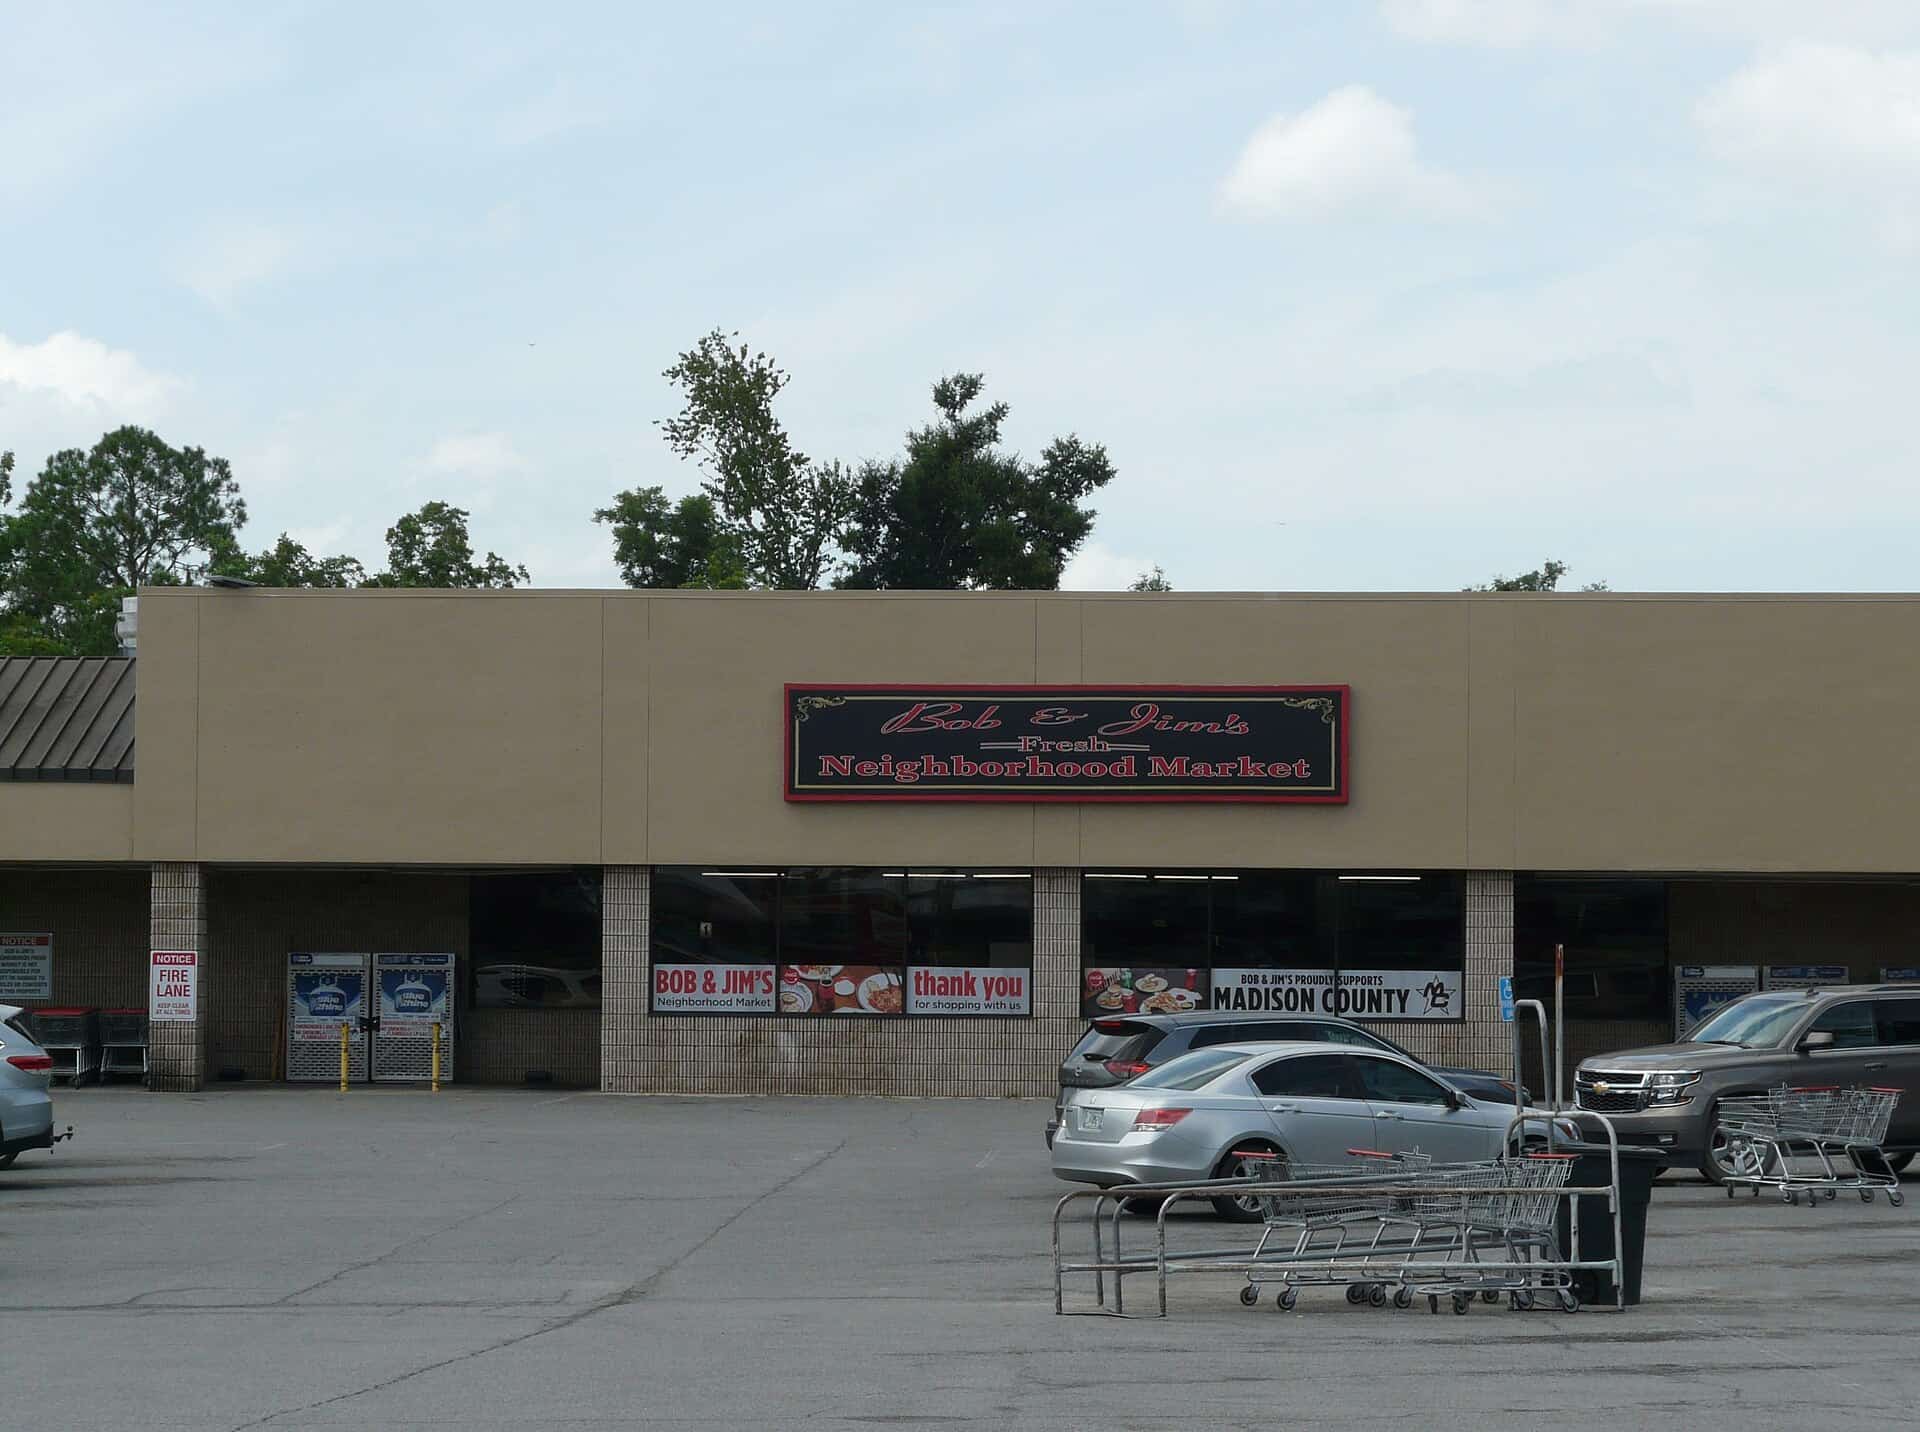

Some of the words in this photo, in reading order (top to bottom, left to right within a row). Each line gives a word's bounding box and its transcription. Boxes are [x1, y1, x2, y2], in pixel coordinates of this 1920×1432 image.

[880, 703, 1002, 734] Bob
[1030, 707, 1089, 725] &
[1097, 703, 1250, 735] Jim's
[1017, 735, 1112, 752] Fresh
[818, 754, 1138, 783] Neighborhood
[1148, 755, 1312, 778] Market
[2, 937, 37, 945] NOTICE
[156, 954, 193, 964] NOTICE
[159, 969, 188, 982] FIRE
[656, 970, 697, 993] BOB
[702, 970, 717, 994] &
[722, 970, 774, 994] JIM'S
[1241, 974, 1260, 985] BOB
[1261, 975, 1268, 985] &
[1270, 975, 1293, 985] JIM'S
[1295, 975, 1334, 985] PROUDLY
[1337, 975, 1384, 985] SUPPORTS
[156, 984, 191, 997] LANE
[914, 970, 977, 997] thank
[982, 976, 1023, 1001] you
[657, 997, 733, 1008] Neighborhood
[736, 998, 771, 1007] Market
[915, 1000, 930, 1009] for
[932, 1000, 981, 1011] shopping
[983, 1000, 1007, 1009] with
[1009, 1001, 1022, 1010] us
[1214, 987, 1315, 1012] MADISON
[1322, 988, 1410, 1013] COUNTY
